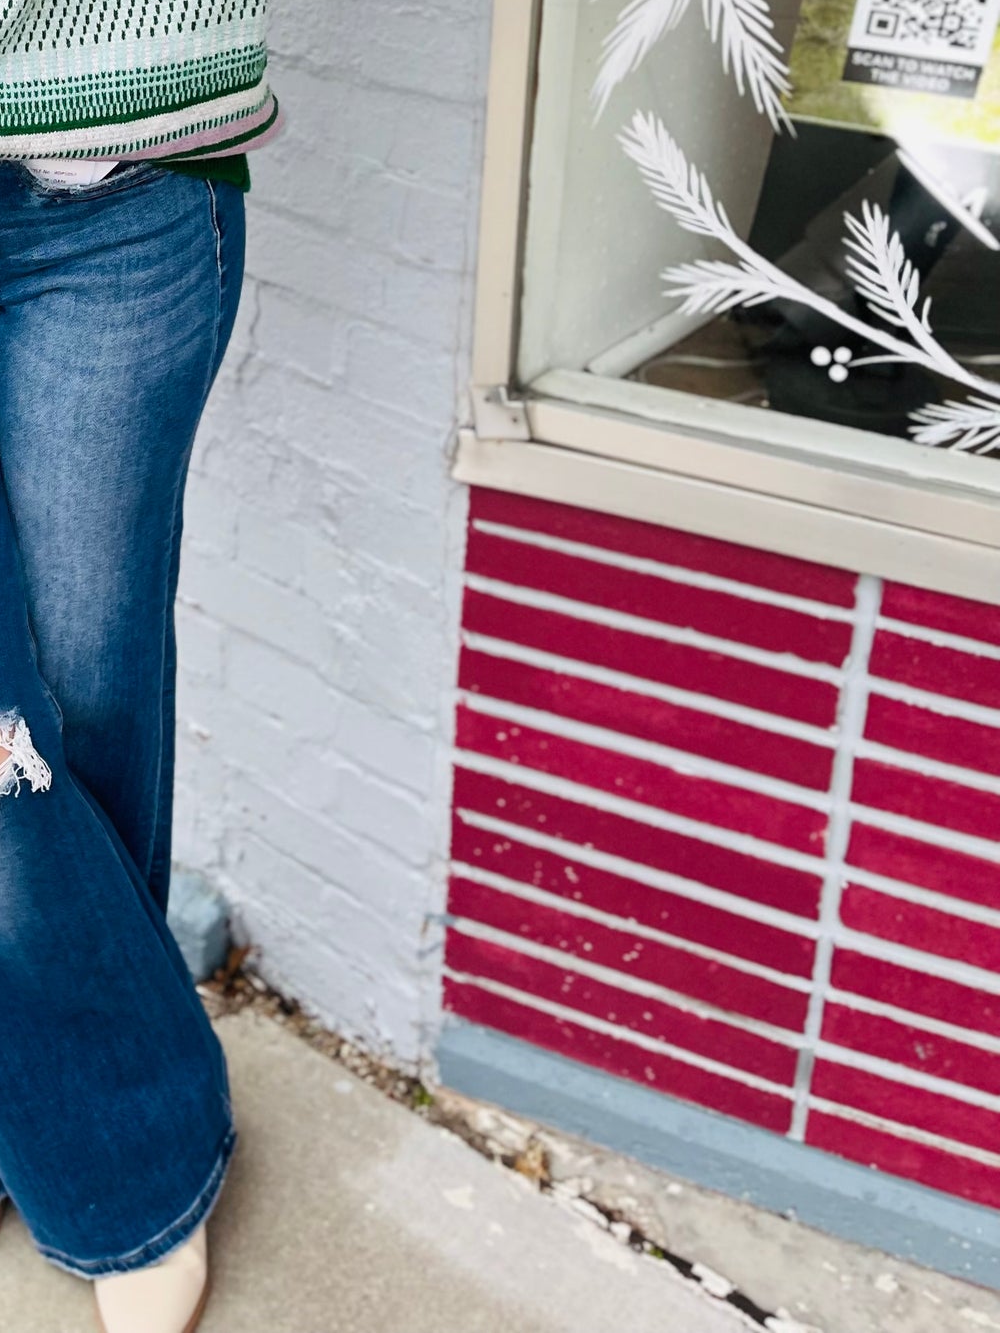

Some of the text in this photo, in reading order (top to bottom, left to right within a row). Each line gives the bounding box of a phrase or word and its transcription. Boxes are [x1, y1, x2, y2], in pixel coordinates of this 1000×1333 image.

[852, 51, 976, 81] SCAN TO WATCH
[870, 68, 950, 92] THE VIDEO
